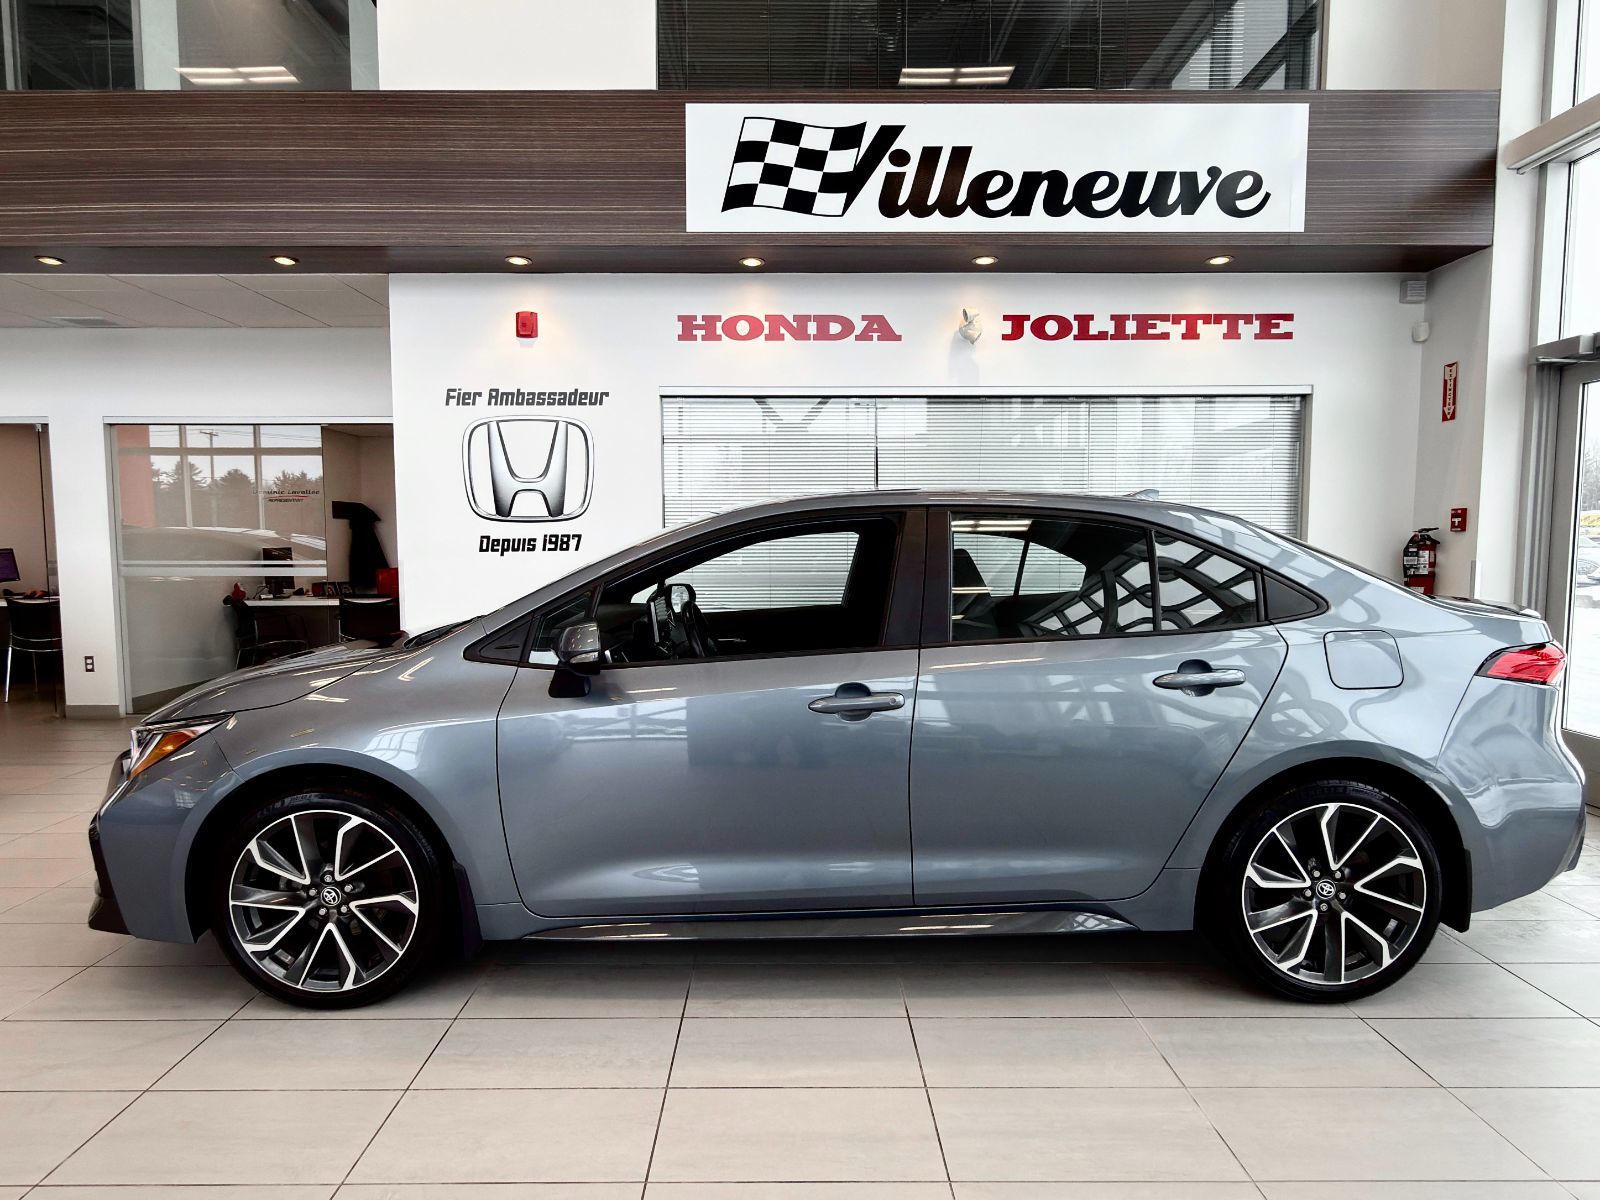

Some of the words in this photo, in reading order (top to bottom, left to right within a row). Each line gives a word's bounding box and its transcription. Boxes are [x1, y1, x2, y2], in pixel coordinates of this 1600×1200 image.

[721, 117, 1272, 219] Villeneuve
[677, 313, 901, 342] HONDA
[1001, 313, 1294, 342] JOLIETTE
[445, 388, 483, 406] Fier
[487, 388, 610, 406] Ambassadeur
[478, 535, 537, 556] Depuis
[541, 533, 583, 552] 1987
